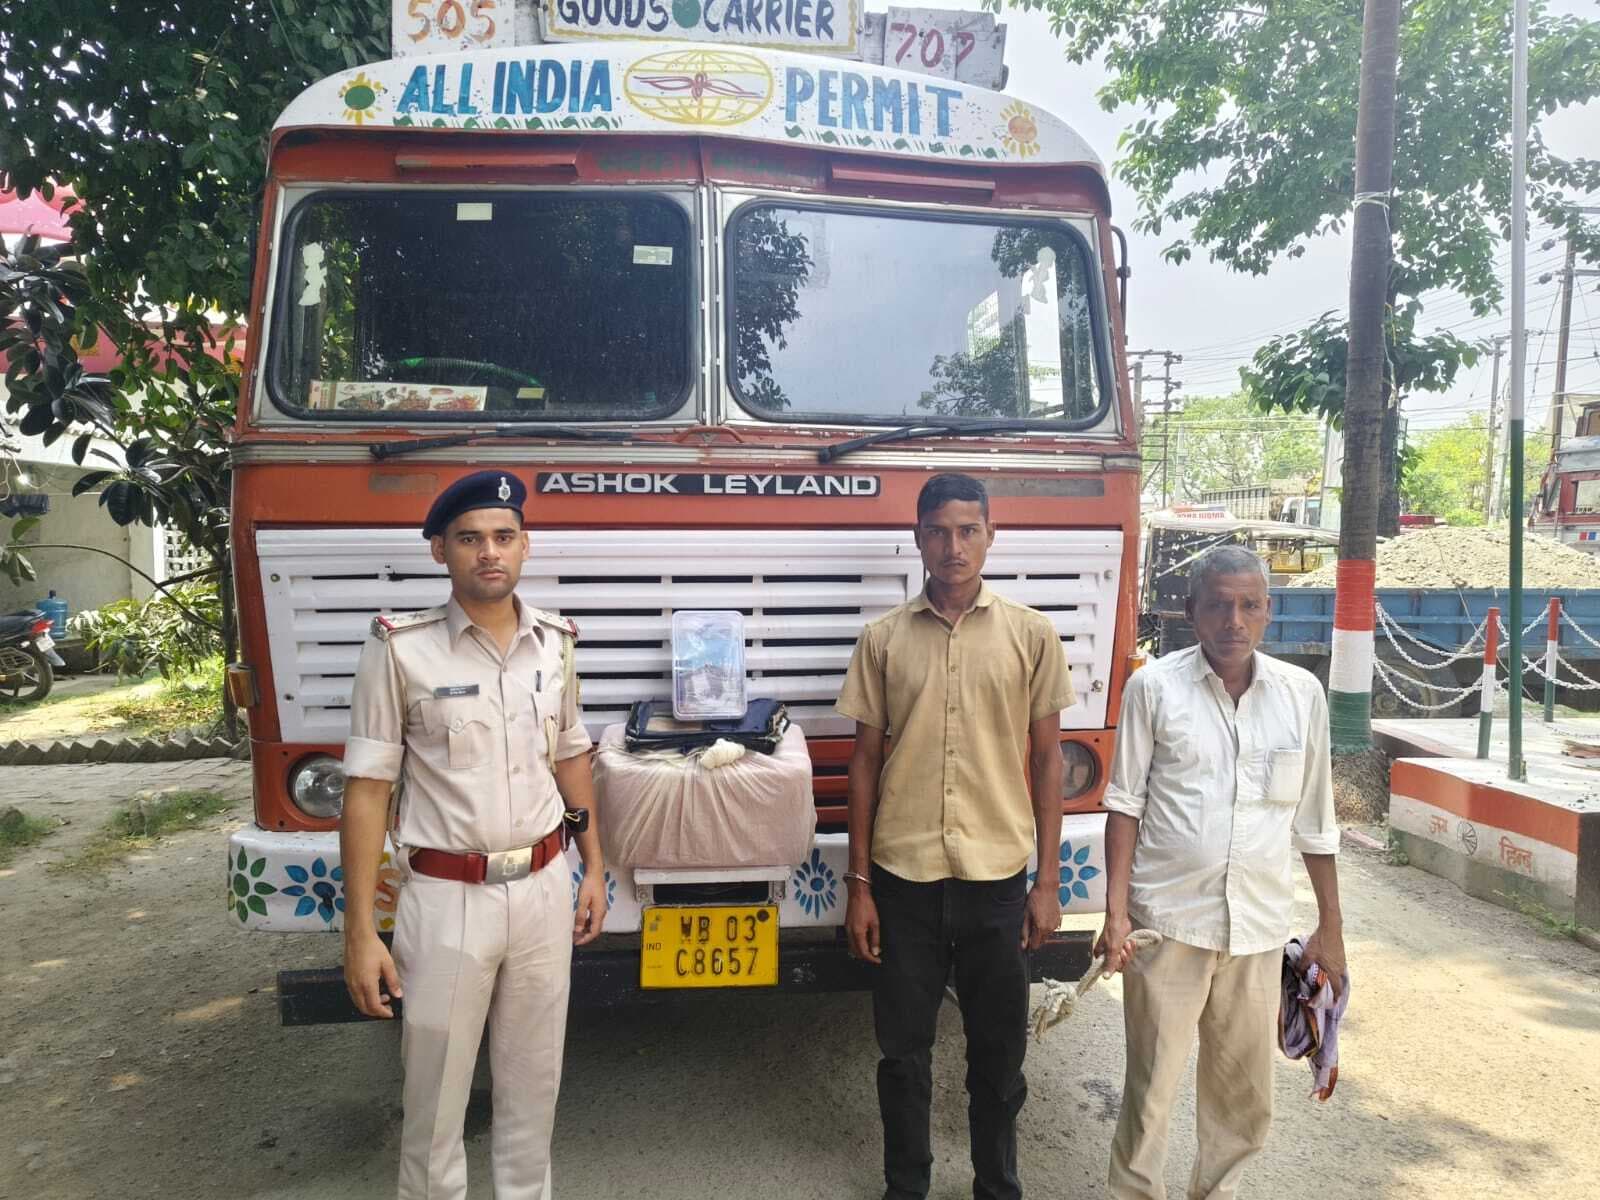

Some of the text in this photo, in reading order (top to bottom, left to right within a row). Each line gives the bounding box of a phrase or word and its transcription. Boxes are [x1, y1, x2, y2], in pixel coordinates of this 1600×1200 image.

[408, 0, 496, 43] 505
[703, 0, 834, 40] CARRIER
[396, 59, 963, 137] ALL INDIA PERMIT
[542, 472, 877, 495] ASHOK LEYLAND
[680, 914, 757, 943] WB 03
[675, 946, 759, 976] C8657
